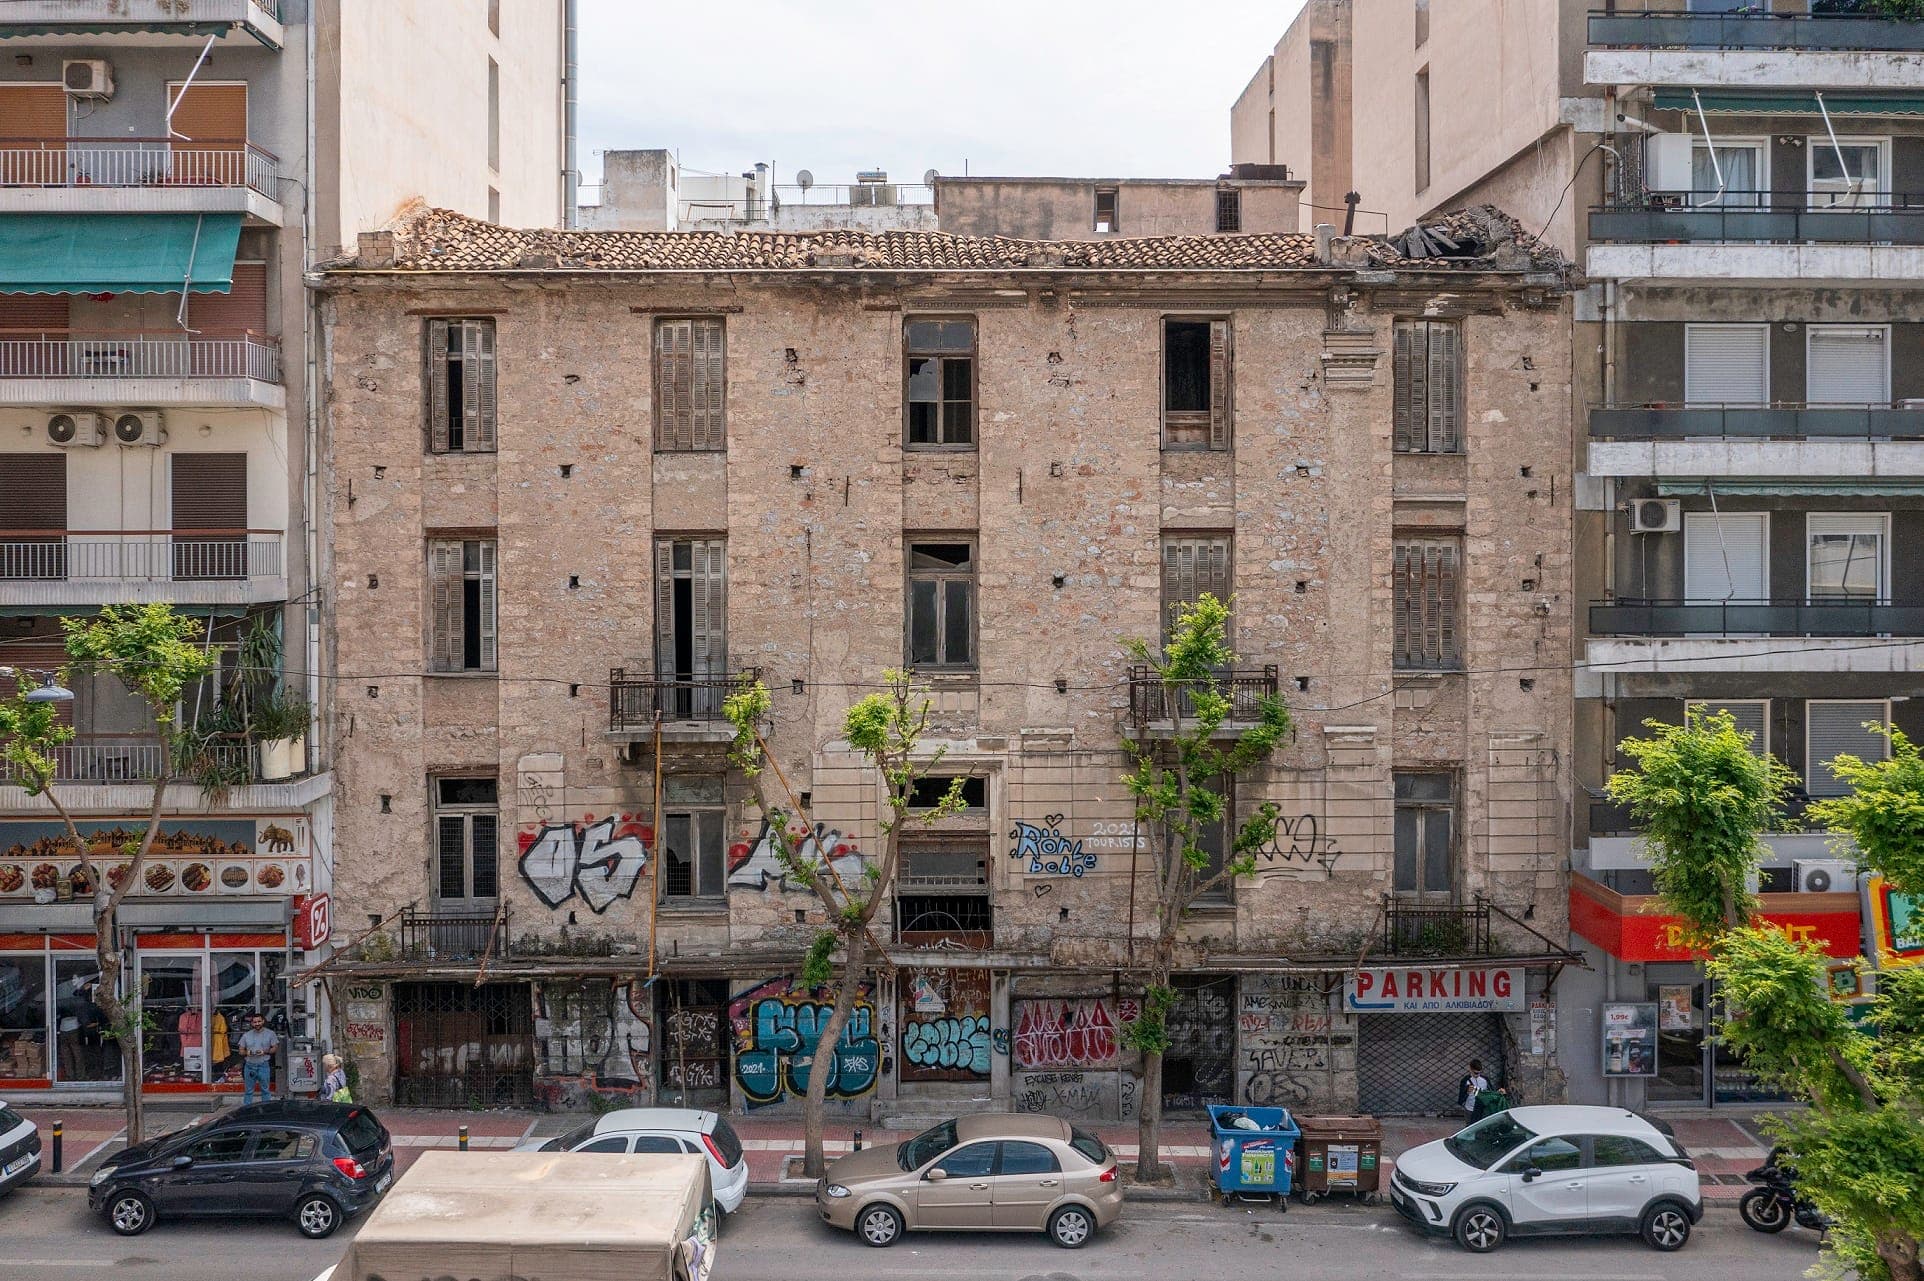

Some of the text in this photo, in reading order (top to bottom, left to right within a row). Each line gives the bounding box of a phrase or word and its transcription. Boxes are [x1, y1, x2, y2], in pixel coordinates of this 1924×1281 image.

[1357, 971, 1511, 998] PARKING
[1422, 1001, 1440, 1009] ΑΠΟ
[1445, 1000, 1493, 1009] ΑΛΚΙΒΙΑΔΟΥ
